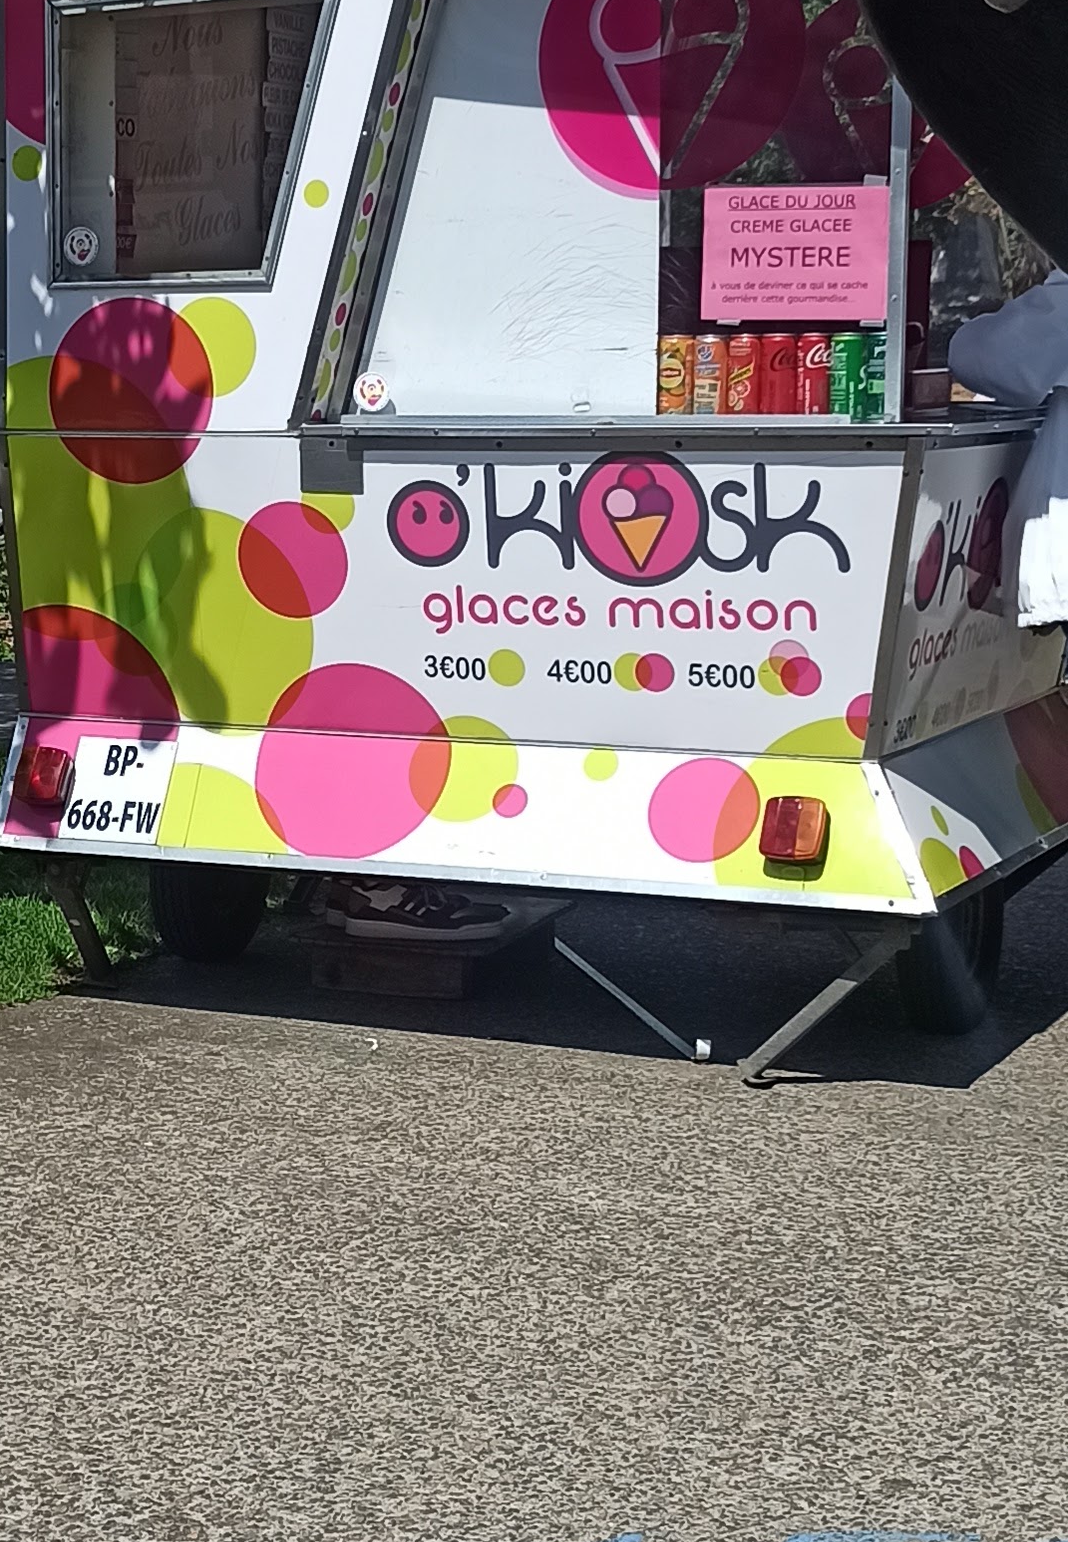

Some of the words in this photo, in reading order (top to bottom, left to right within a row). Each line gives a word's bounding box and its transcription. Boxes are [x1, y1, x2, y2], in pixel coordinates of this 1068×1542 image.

[273, 10, 305, 32] VANILLE
[152, 13, 223, 57] Nous
[272, 36, 306, 58] PISTACHE
[728, 195, 780, 209] GLACE
[785, 194, 809, 208] DU
[814, 194, 856, 208] JOUR
[730, 220, 784, 233] CREME
[790, 219, 852, 232] GLACEE
[731, 246, 851, 268] MYSTERE
[719, 282, 741, 290] vous
[743, 281, 756, 290] de
[758, 281, 793, 290] deviner
[795, 282, 807, 290] ce
[809, 281, 825, 291] qui
[827, 282, 838, 290] se
[840, 281, 869, 290] cache
[761, 294, 784, 303] cette
[423, 585, 586, 634] glaces
[608, 589, 817, 631] maison
[908, 627, 958, 681] glaces
[423, 654, 486, 679] 3€00
[547, 659, 612, 684] 4€00
[688, 663, 755, 688] 5€00
[103, 745, 144, 776] BP-
[67, 799, 161, 834] 668-FW
